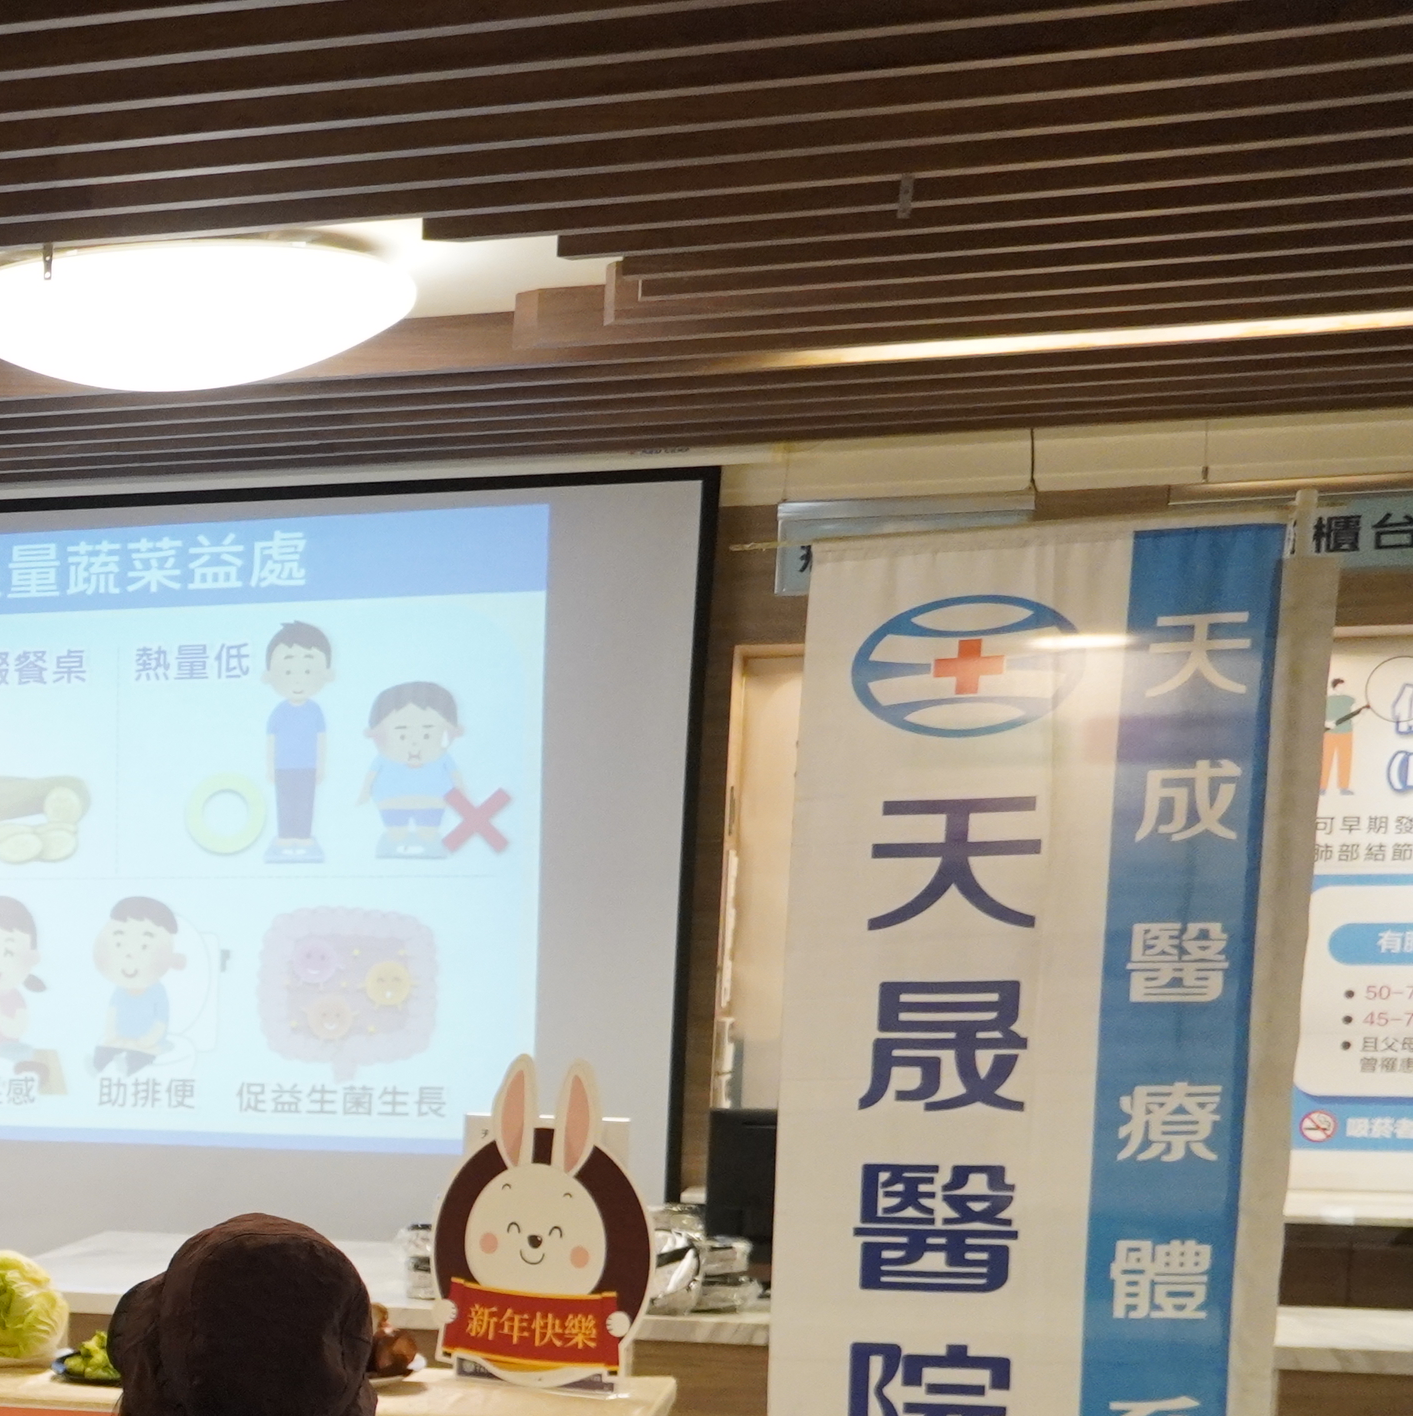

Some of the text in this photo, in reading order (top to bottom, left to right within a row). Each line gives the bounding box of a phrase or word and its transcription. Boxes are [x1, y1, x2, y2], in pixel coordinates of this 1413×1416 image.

[134, 643, 251, 684] 熱量低
[97, 1077, 197, 1110] 助排便
[235, 1081, 447, 1118] 促益生菌生長
[466, 1304, 598, 1350] 新年快樂
